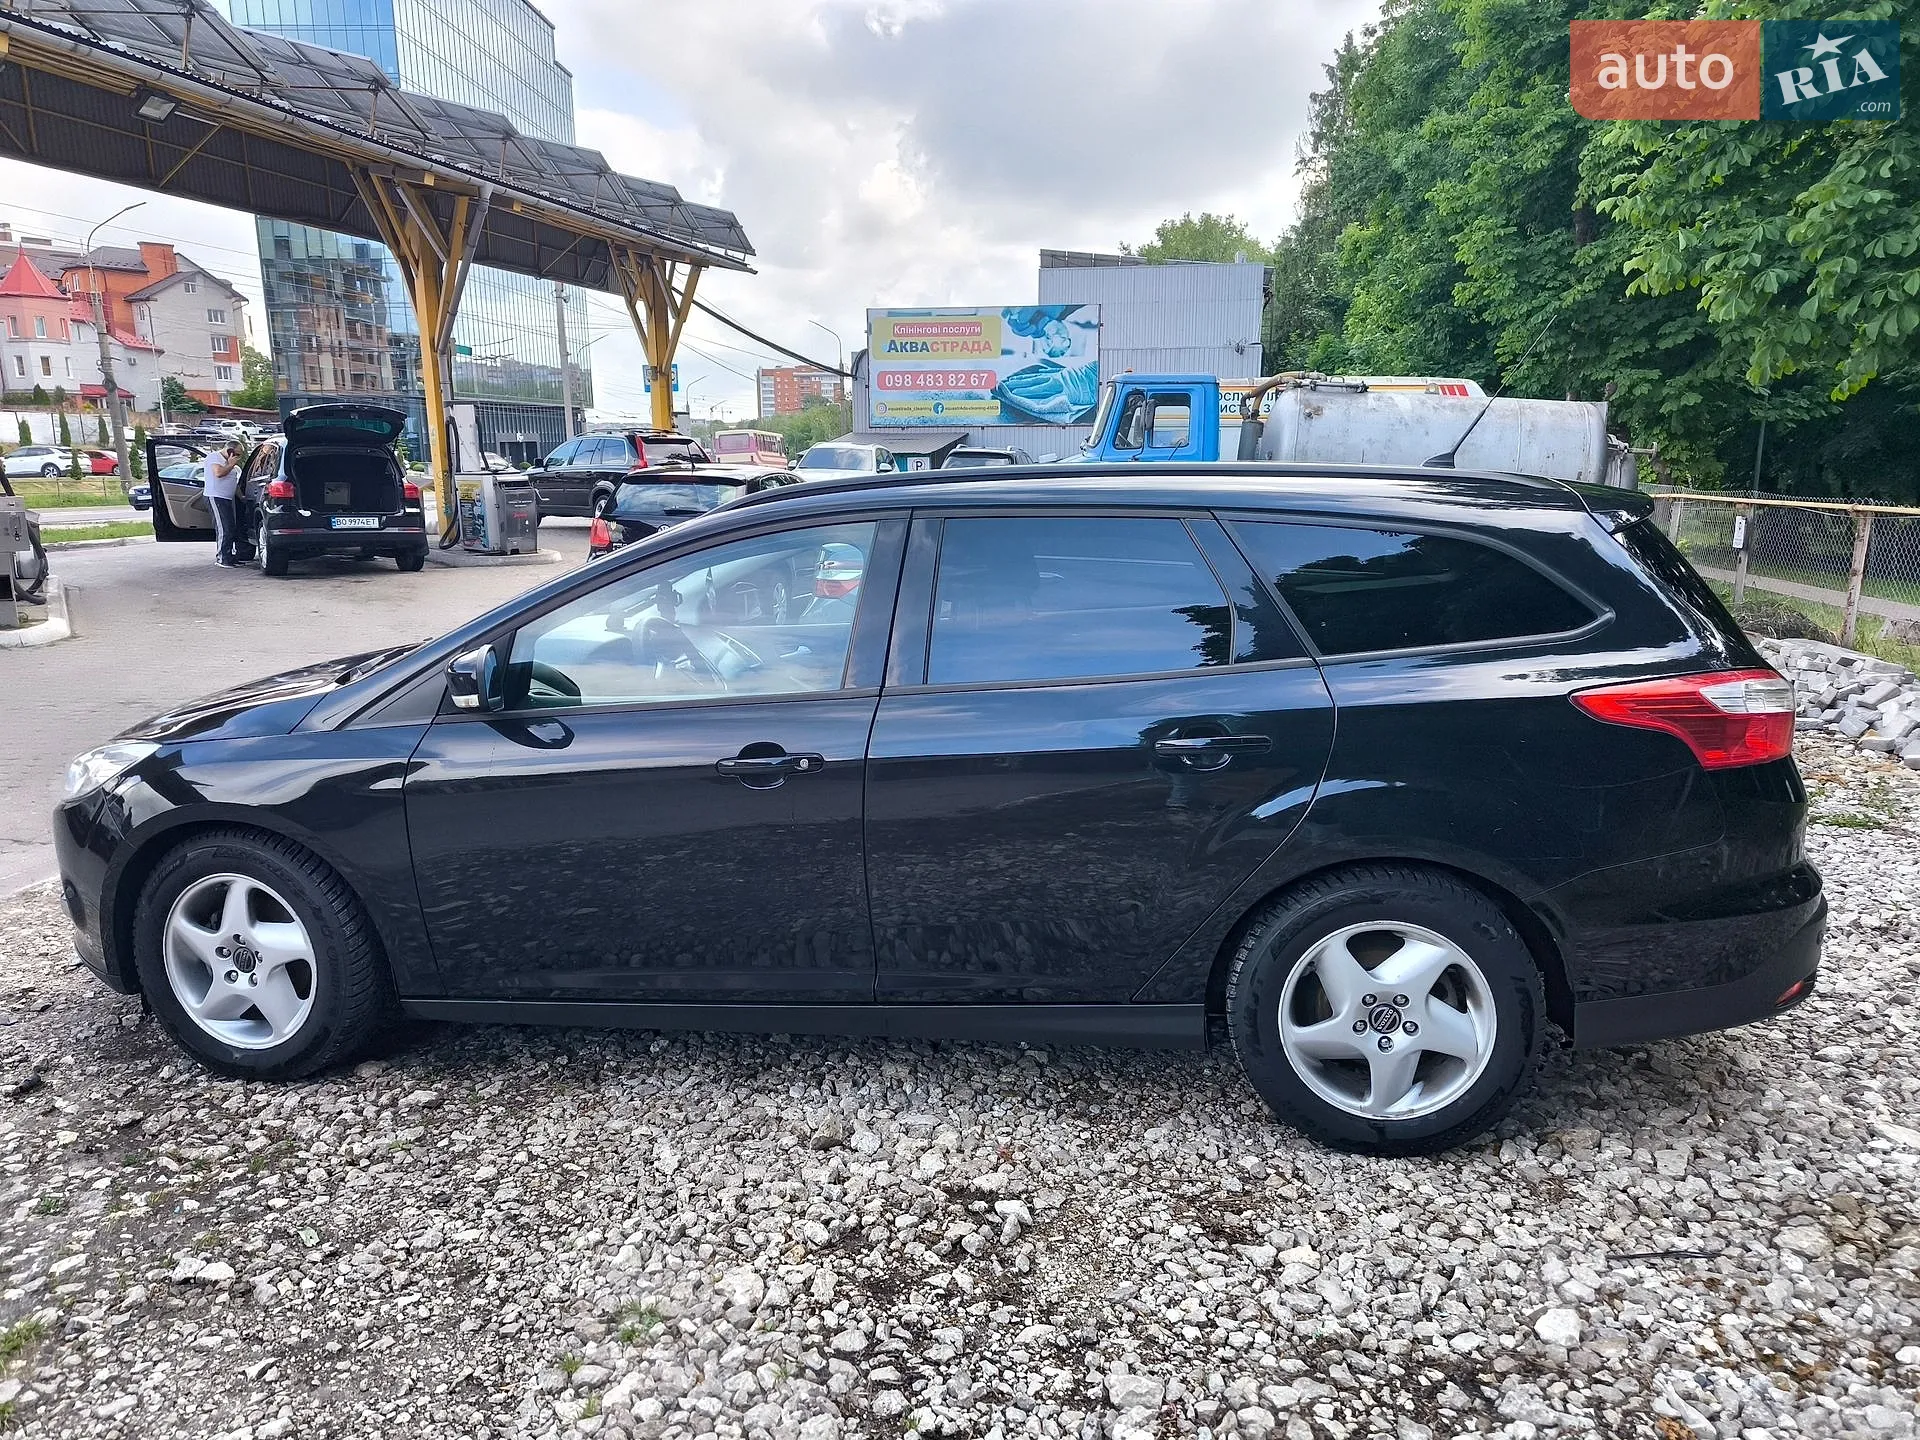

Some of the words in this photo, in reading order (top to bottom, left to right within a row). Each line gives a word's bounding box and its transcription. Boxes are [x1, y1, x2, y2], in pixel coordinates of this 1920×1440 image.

[894, 325, 941, 335] Клінінгові
[943, 325, 981, 335] послуги
[887, 339, 992, 353] АКВАСТРАДА
[885, 374, 913, 387] 098
[916, 374, 944, 387] 483
[948, 373, 967, 386] 82
[971, 373, 989, 386] 67
[1377, 1008, 1393, 1030] VOLVO
